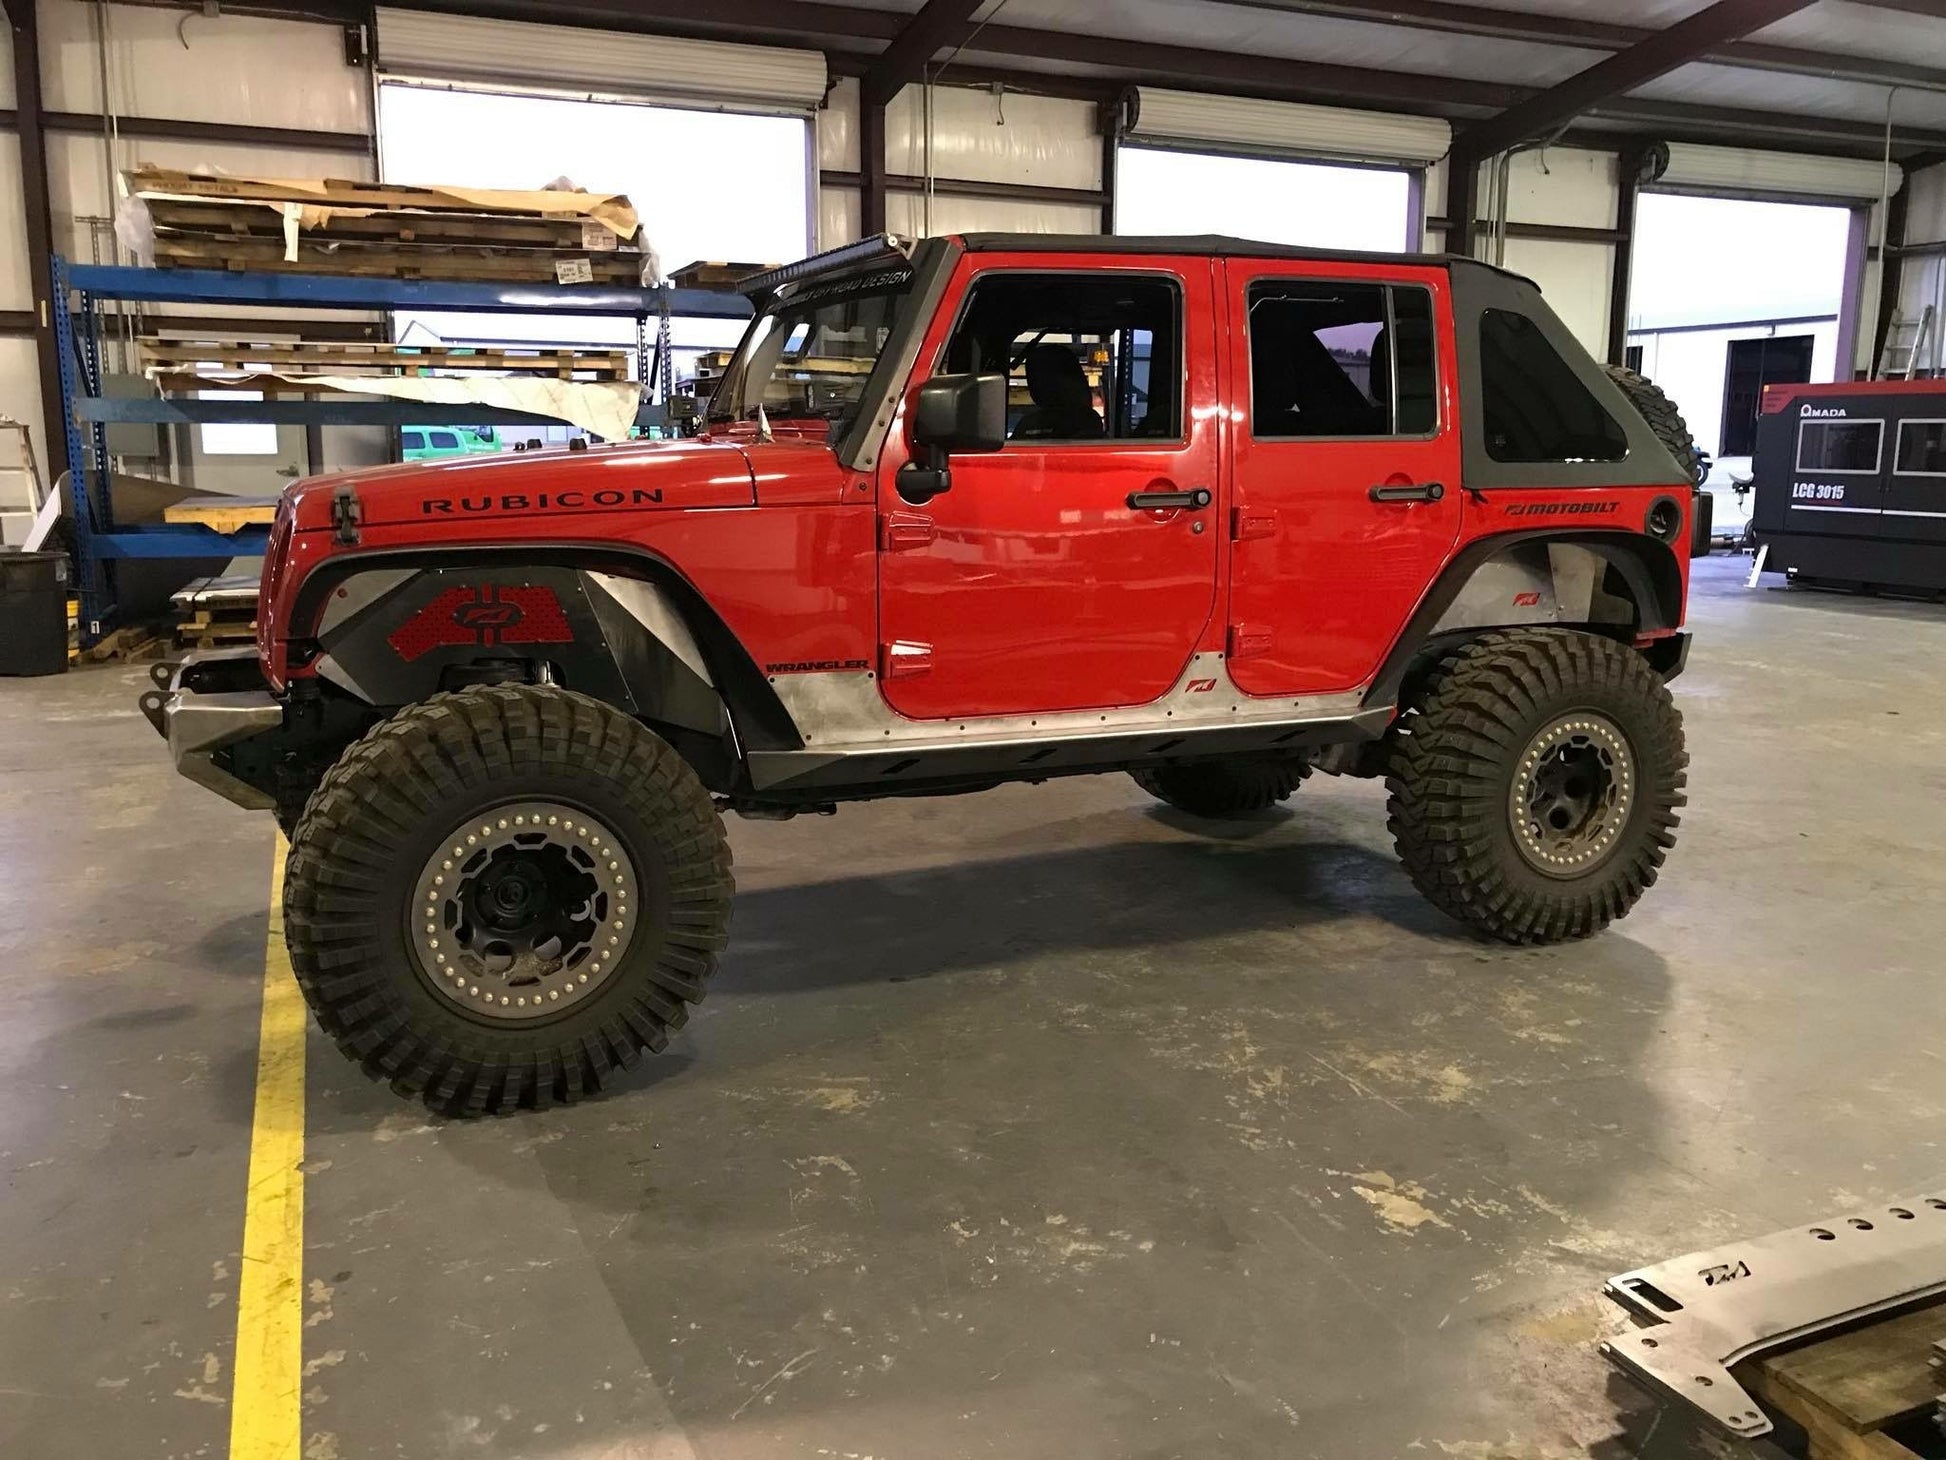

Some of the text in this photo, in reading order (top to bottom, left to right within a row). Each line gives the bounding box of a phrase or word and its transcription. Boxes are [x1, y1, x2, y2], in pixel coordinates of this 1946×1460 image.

[861, 270, 912, 289] DESIGN
[1792, 483, 1845, 500] LCG 3015
[422, 489, 664, 514] RUBICON
[1525, 502, 1620, 516] MOTOBILT
[766, 660, 869, 672] WRANGLER
